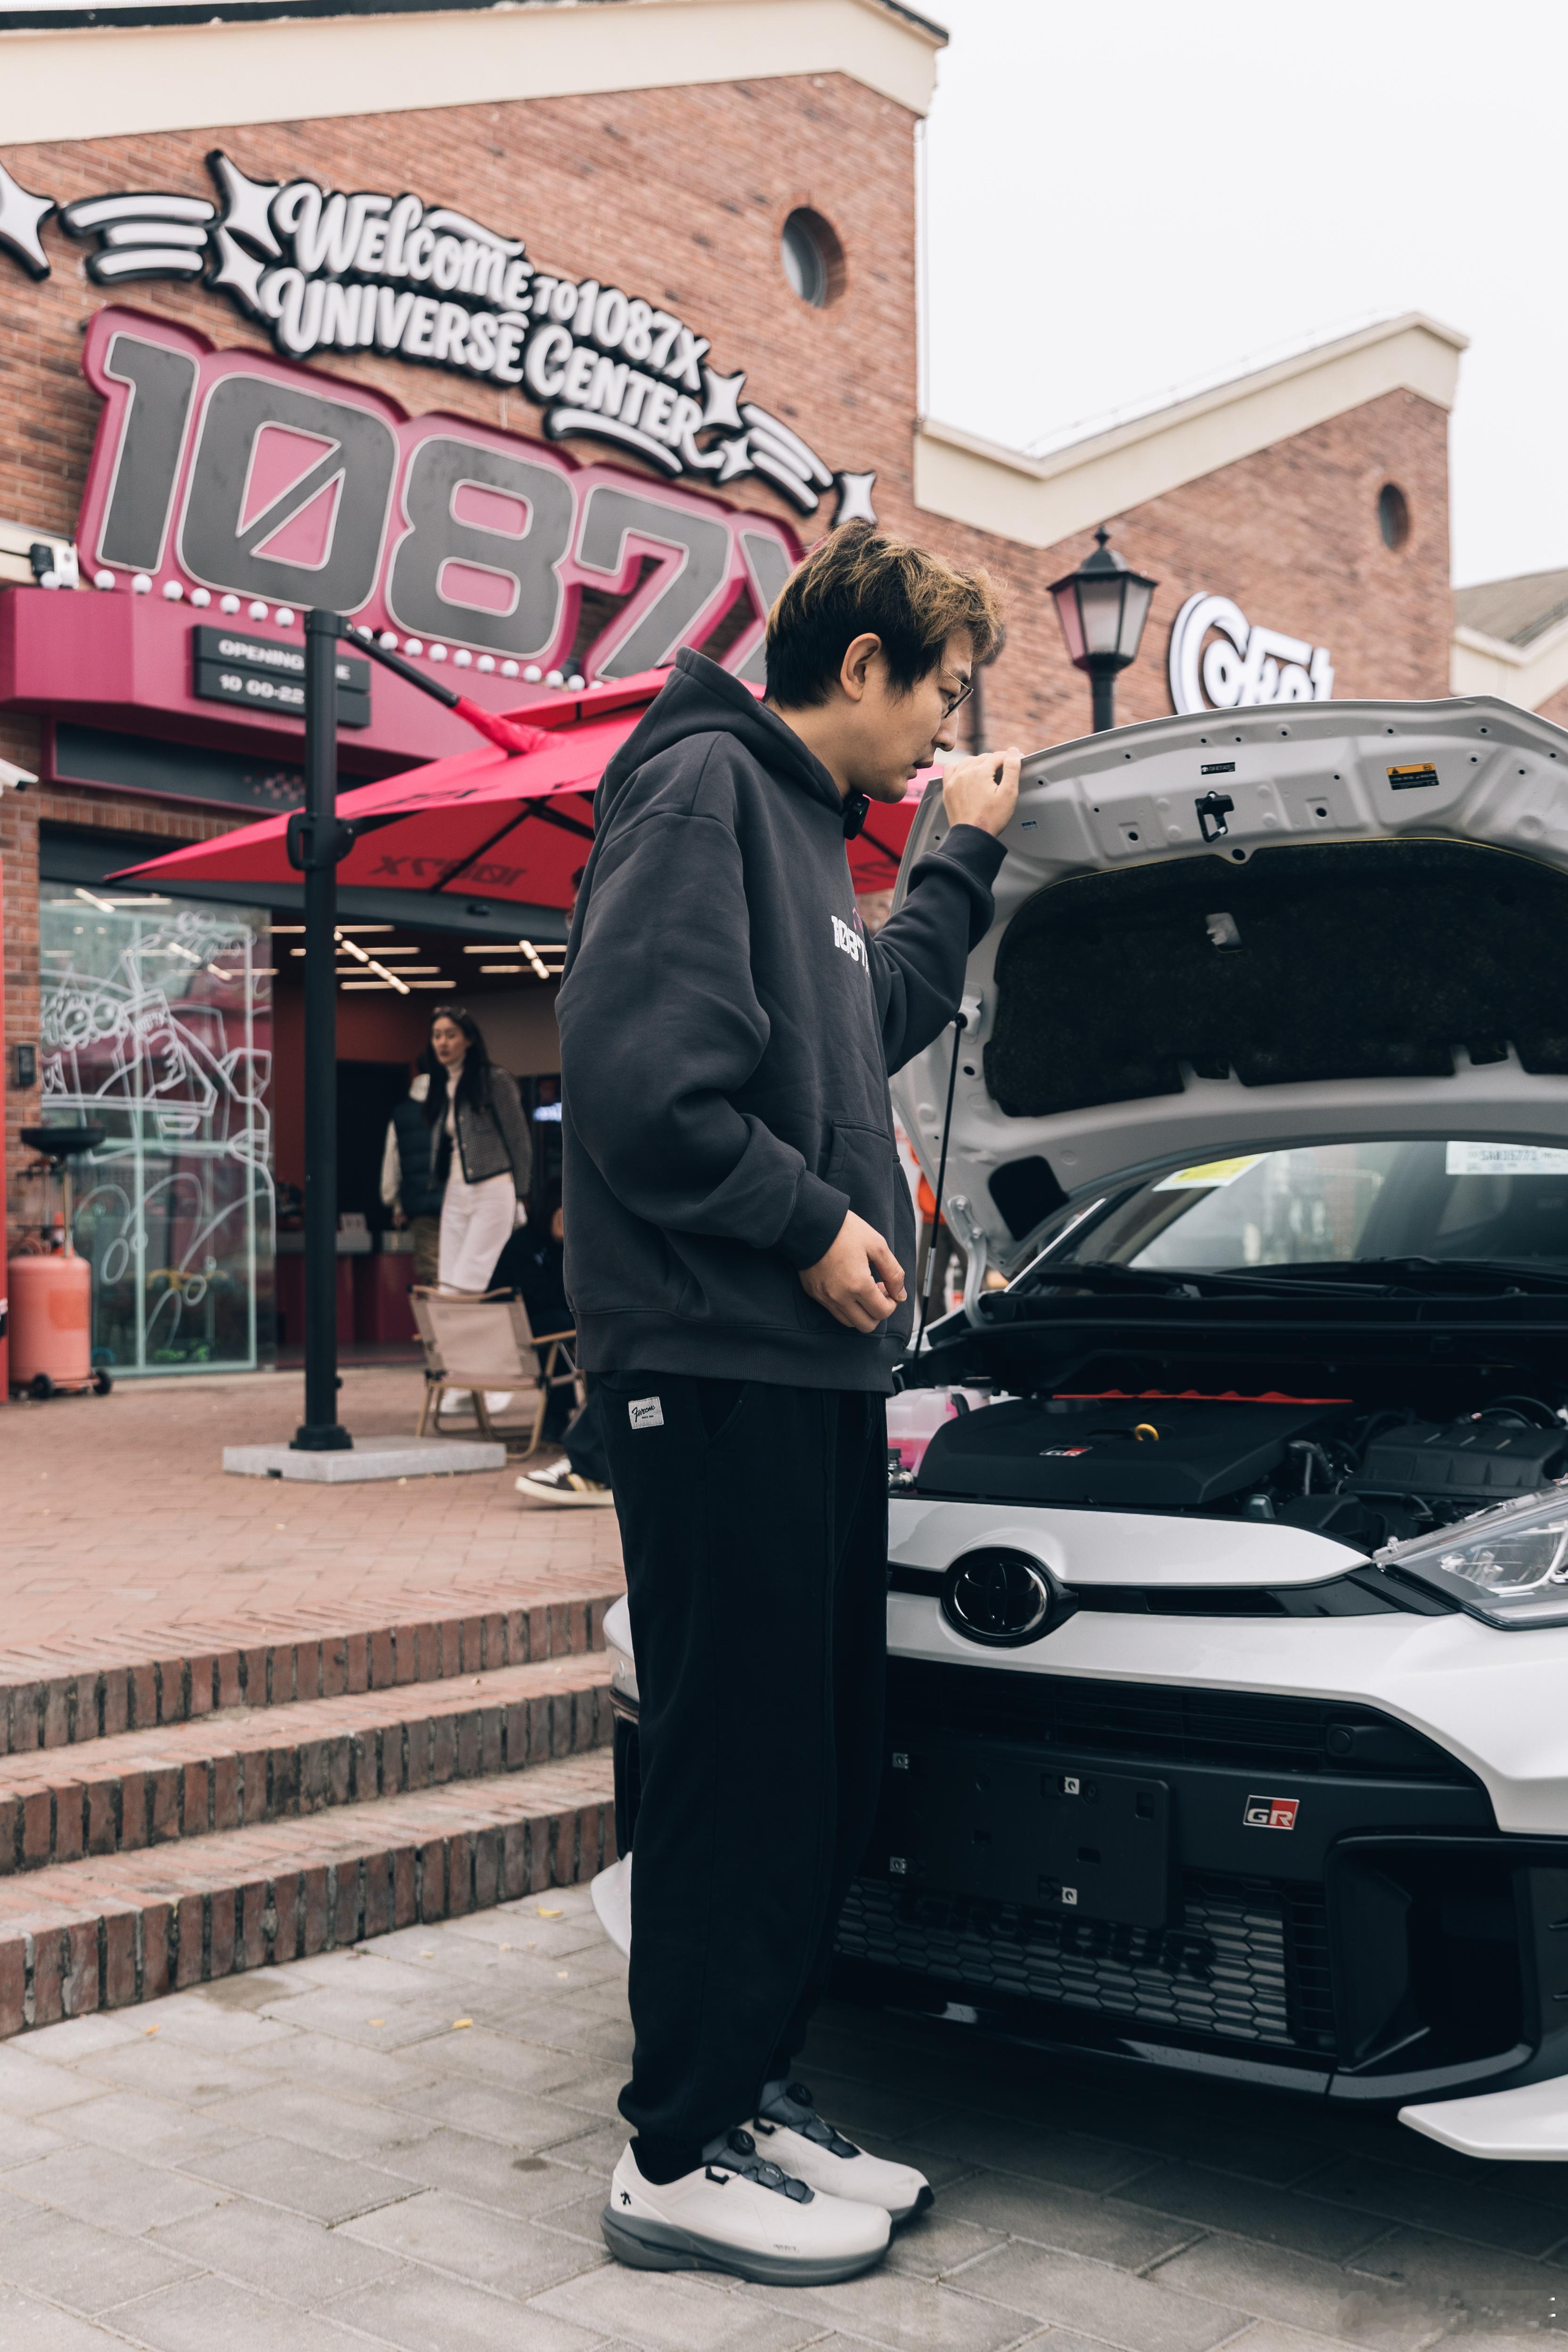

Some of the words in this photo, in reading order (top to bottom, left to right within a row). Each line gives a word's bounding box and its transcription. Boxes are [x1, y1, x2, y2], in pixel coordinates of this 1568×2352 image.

[569, 280, 711, 391] 1087X
[259, 267, 530, 383] UNIVERSE
[524, 324, 722, 466] CENTER
[218, 639, 305, 671] OPENING
[219, 674, 243, 692] 10
[1247, 1808, 1293, 1826] GR
